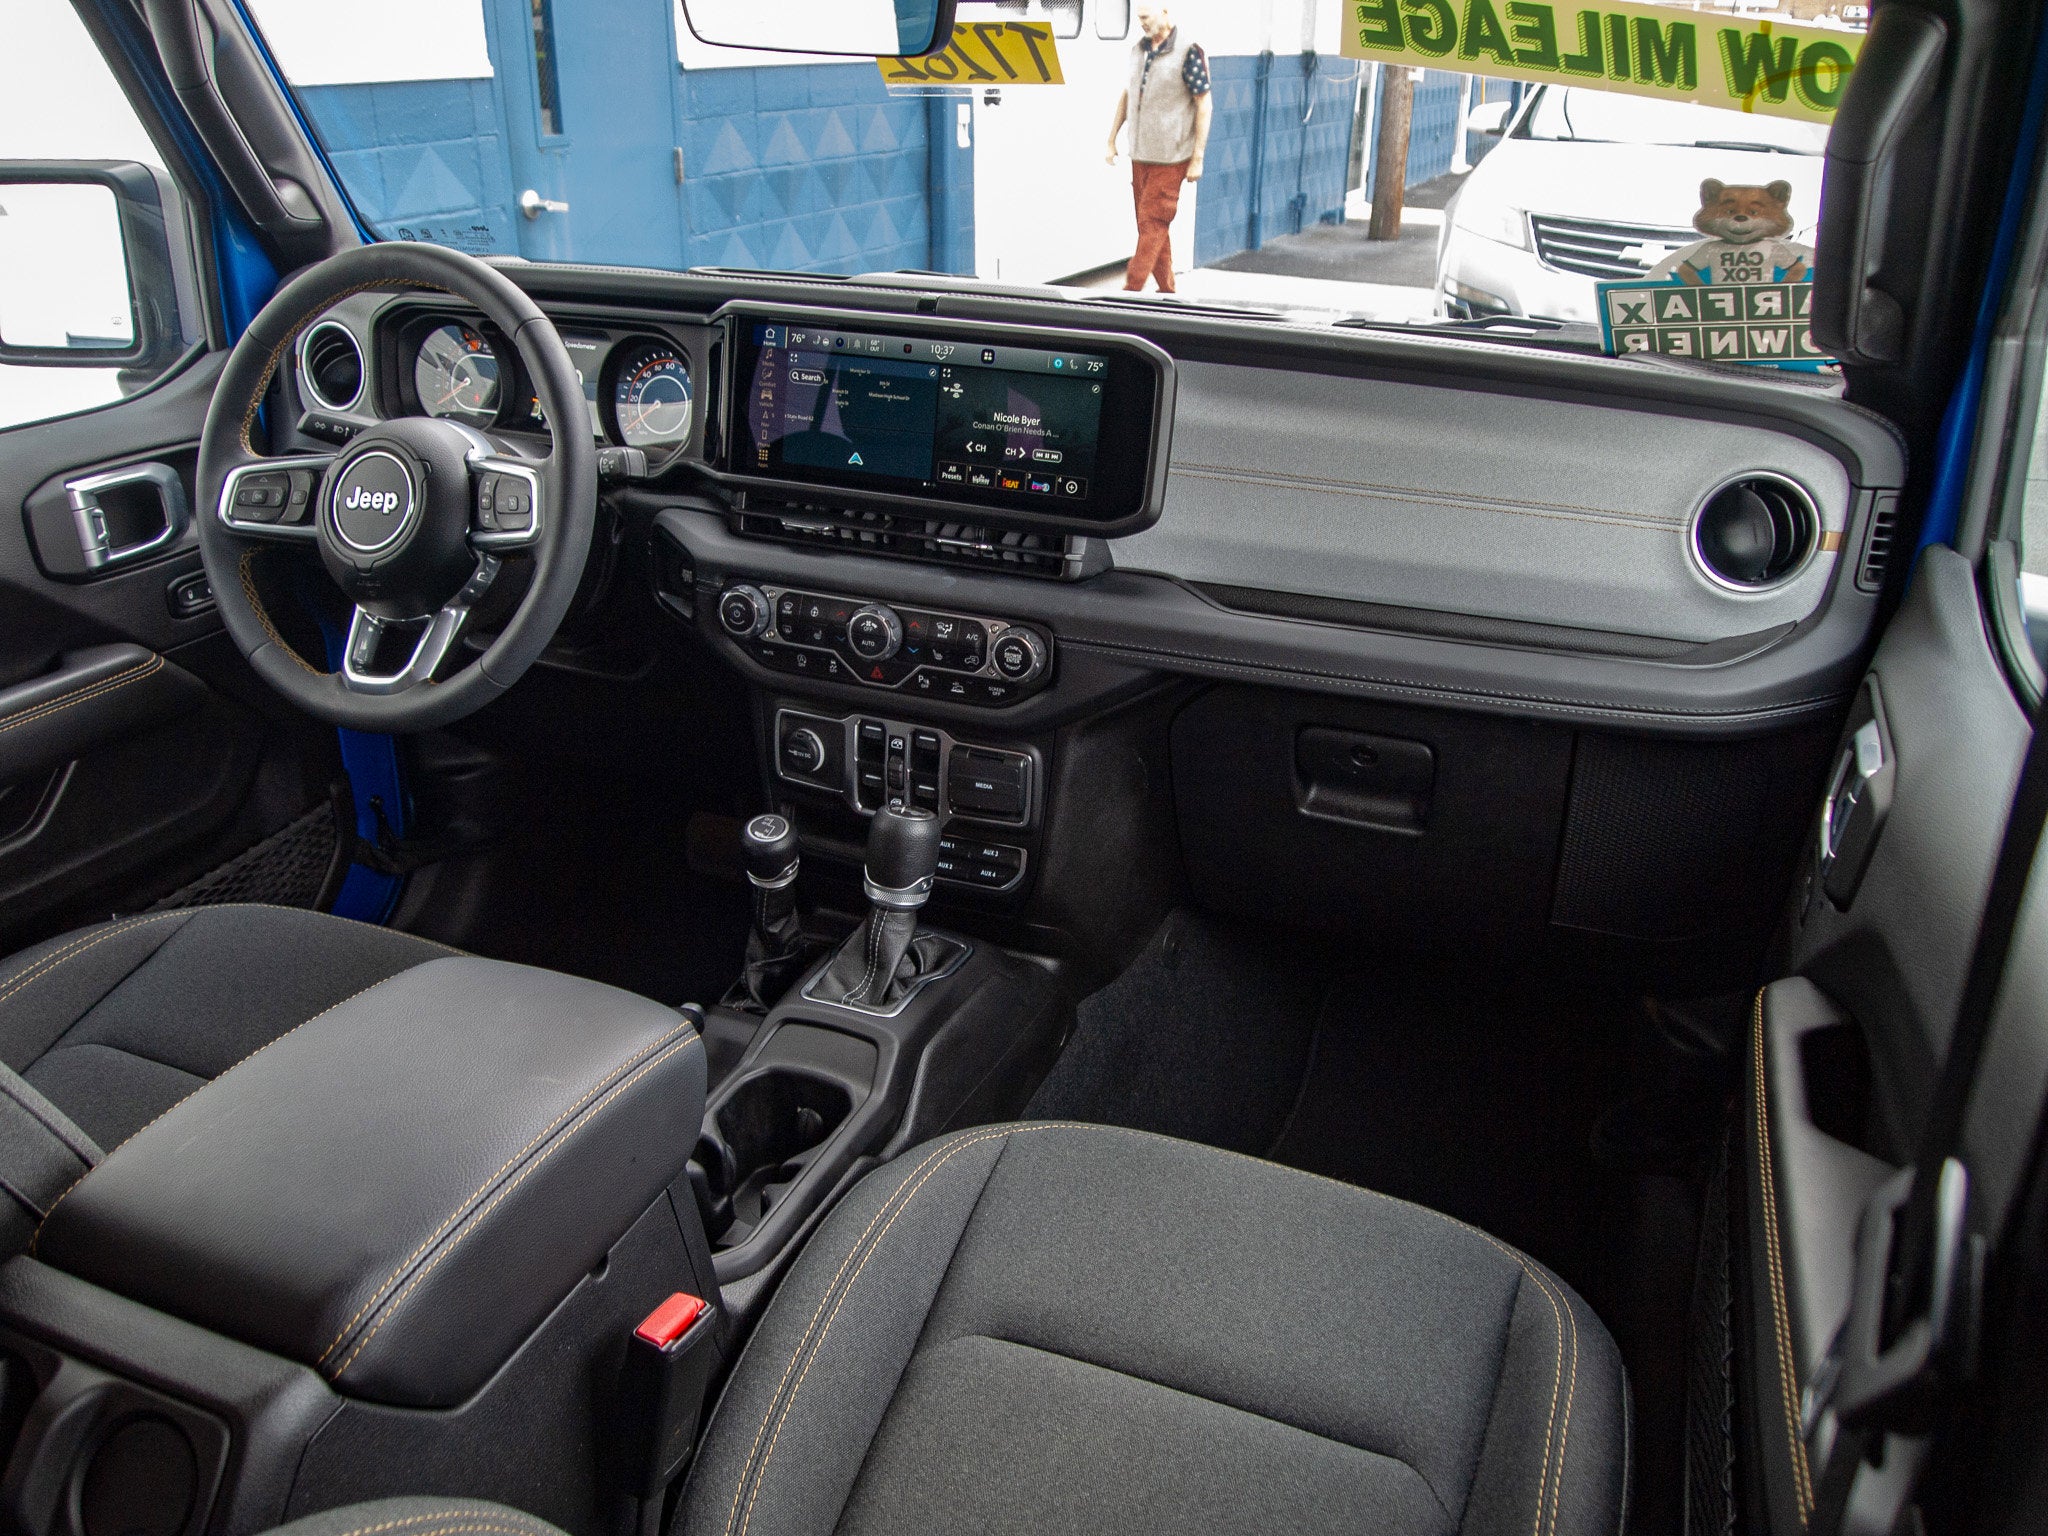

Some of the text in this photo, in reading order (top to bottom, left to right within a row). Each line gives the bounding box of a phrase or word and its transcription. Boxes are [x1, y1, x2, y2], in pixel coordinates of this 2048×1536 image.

[564, 340, 597, 351] Speedometer
[930, 344, 955, 355] 10:37
[1087, 361, 1104, 372] 75°
[801, 373, 821, 382] Search
[993, 412, 1041, 427] Nicole Byer
[972, 421, 995, 430] Conan
[995, 423, 1022, 434] O'Brien
[1023, 427, 1045, 437] Needs
[975, 444, 987, 453] CH
[1005, 447, 1017, 456] CH
[948, 465, 957, 473] All
[941, 471, 962, 481] Presets
[345, 485, 399, 514] Jeep
[966, 633, 979, 641] A/C
[988, 686, 1006, 694] SCREEN
[975, 782, 993, 790] MEDIA
[940, 840, 951, 848] AUX
[982, 848, 994, 856] AUX
[938, 861, 949, 869] AUX
[980, 869, 992, 877] AUX
